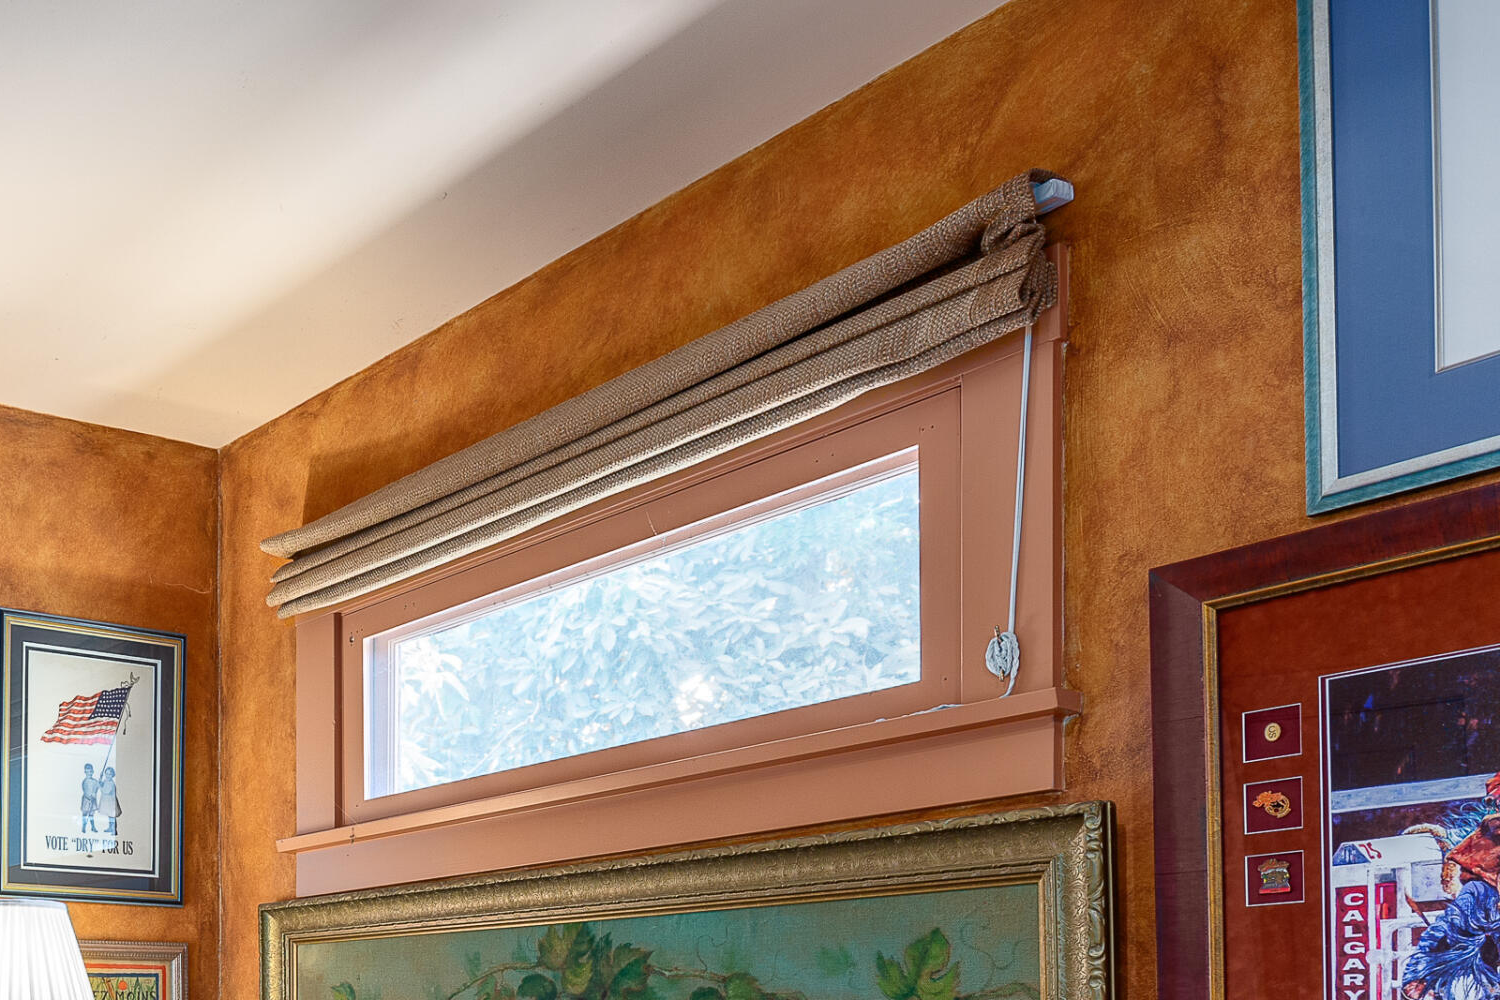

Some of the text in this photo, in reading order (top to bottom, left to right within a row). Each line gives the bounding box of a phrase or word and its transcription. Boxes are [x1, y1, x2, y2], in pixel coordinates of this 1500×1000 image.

[45, 835, 69, 851] VOTE
[102, 839, 120, 855] FOR
[122, 840, 134, 856] US
